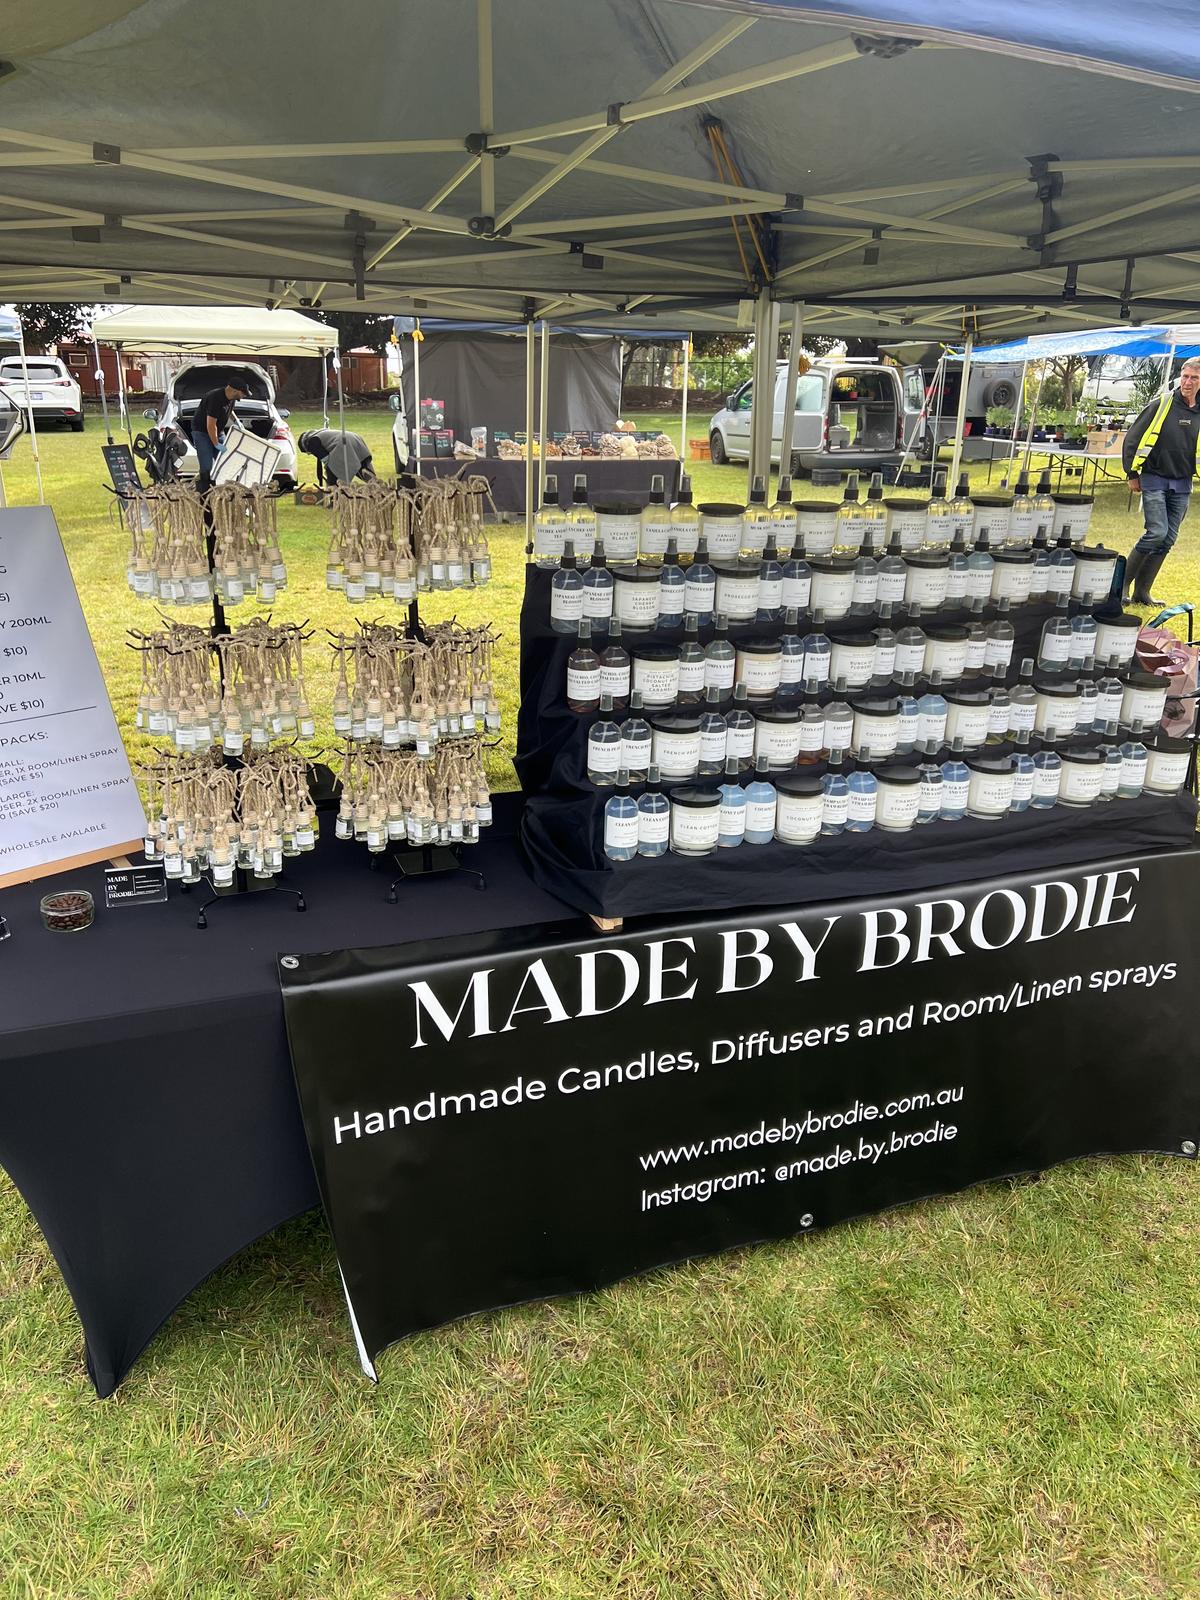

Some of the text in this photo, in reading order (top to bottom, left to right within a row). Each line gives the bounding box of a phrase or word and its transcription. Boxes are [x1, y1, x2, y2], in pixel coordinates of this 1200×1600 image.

[9, 616, 52, 628] 200ML
[3, 646, 27, 656] $10)
[12, 672, 46, 683] 10ML
[20, 698, 44, 710] $10)
[0, 731, 48, 747] PACKS:
[15, 766, 25, 774] 1X
[28, 753, 88, 772] ROOM/LINEN
[90, 748, 118, 759] SPRAY
[29, 772, 44, 780] $5)
[27, 798, 38, 806] 2X
[40, 784, 100, 802] ROOM/LINEN
[102, 777, 130, 789] SPRAY
[9, 807, 37, 820] (SAVE
[40, 802, 59, 812] $20)
[0, 823, 107, 856] WHOLESALE AVALABLE
[108, 890, 134, 898] BRODIE
[407, 867, 1140, 1049] MADE BY BRODIE
[333, 961, 1178, 1144] Handmade Candles, Diffusers and Room/Linen sprays
[639, 1086, 964, 1171] www.madebybrodie.com.au
[641, 1121, 958, 1211] Instagram: @made.by.brodie
